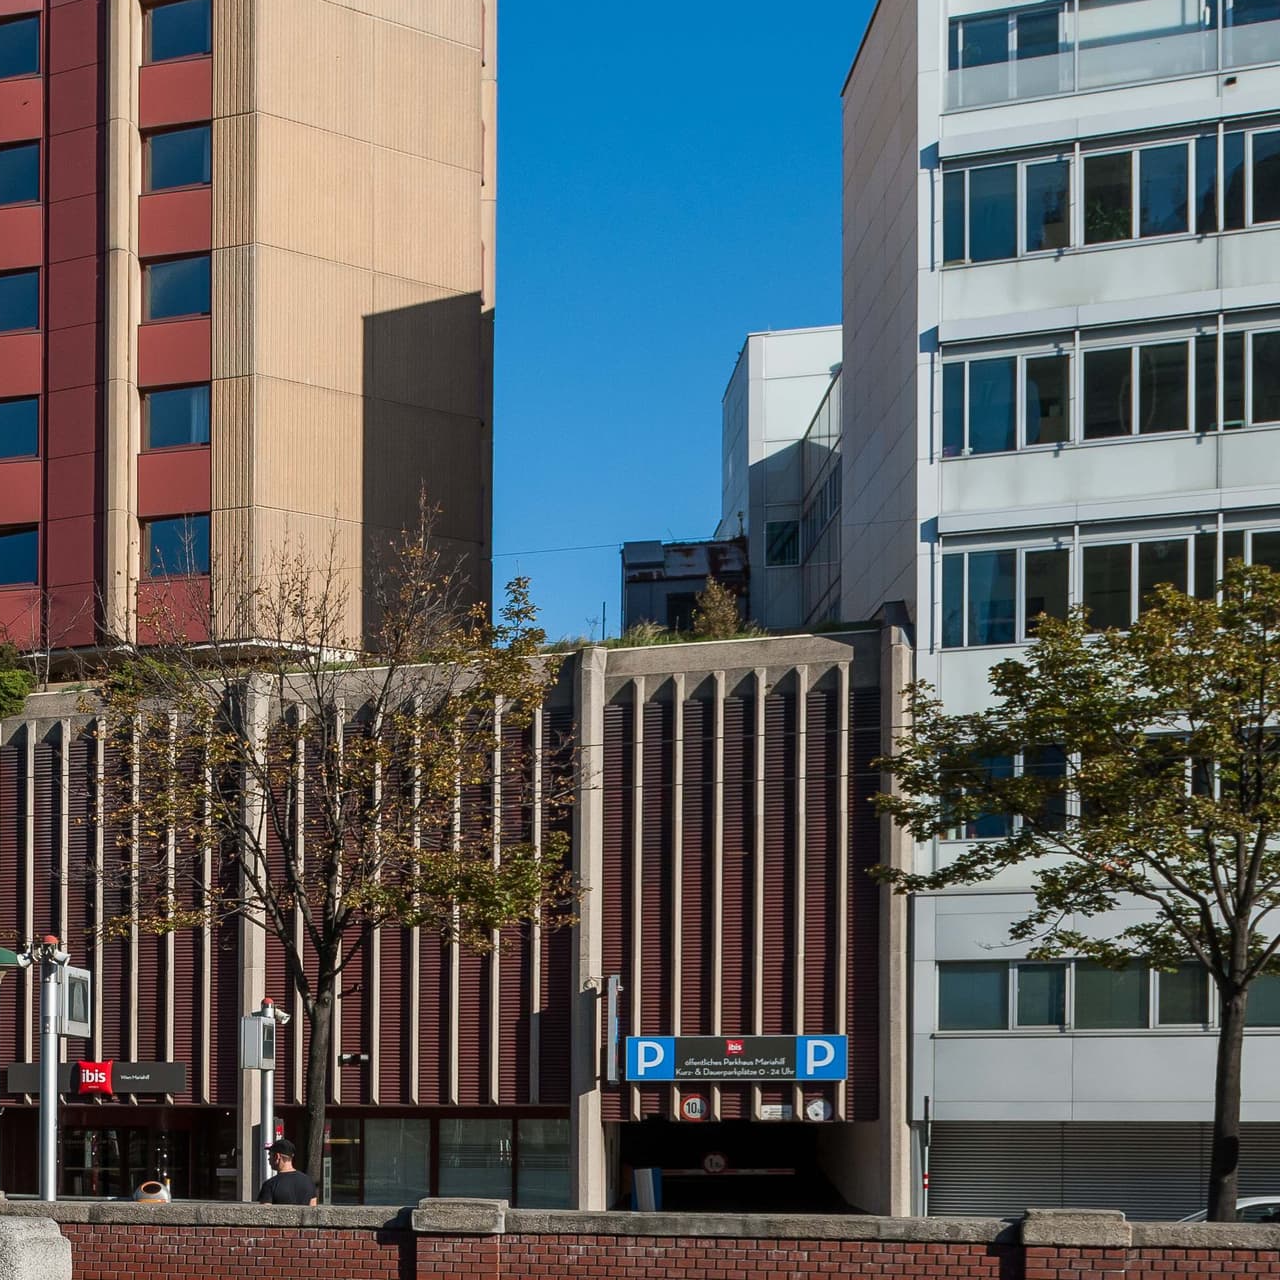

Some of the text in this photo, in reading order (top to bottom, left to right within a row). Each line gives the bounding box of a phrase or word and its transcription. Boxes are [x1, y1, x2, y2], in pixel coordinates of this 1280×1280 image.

[728, 1043, 742, 1051] ibis
[637, 1041, 664, 1076] P
[723, 1057, 753, 1066] Parkhaus
[755, 1057, 786, 1066] Mariahilf
[806, 1040, 835, 1075] P
[81, 1069, 107, 1083] ibis
[770, 1068, 780, 1076] 24
[781, 1067, 795, 1075] Uhr
[685, 1102, 697, 1114] 10
